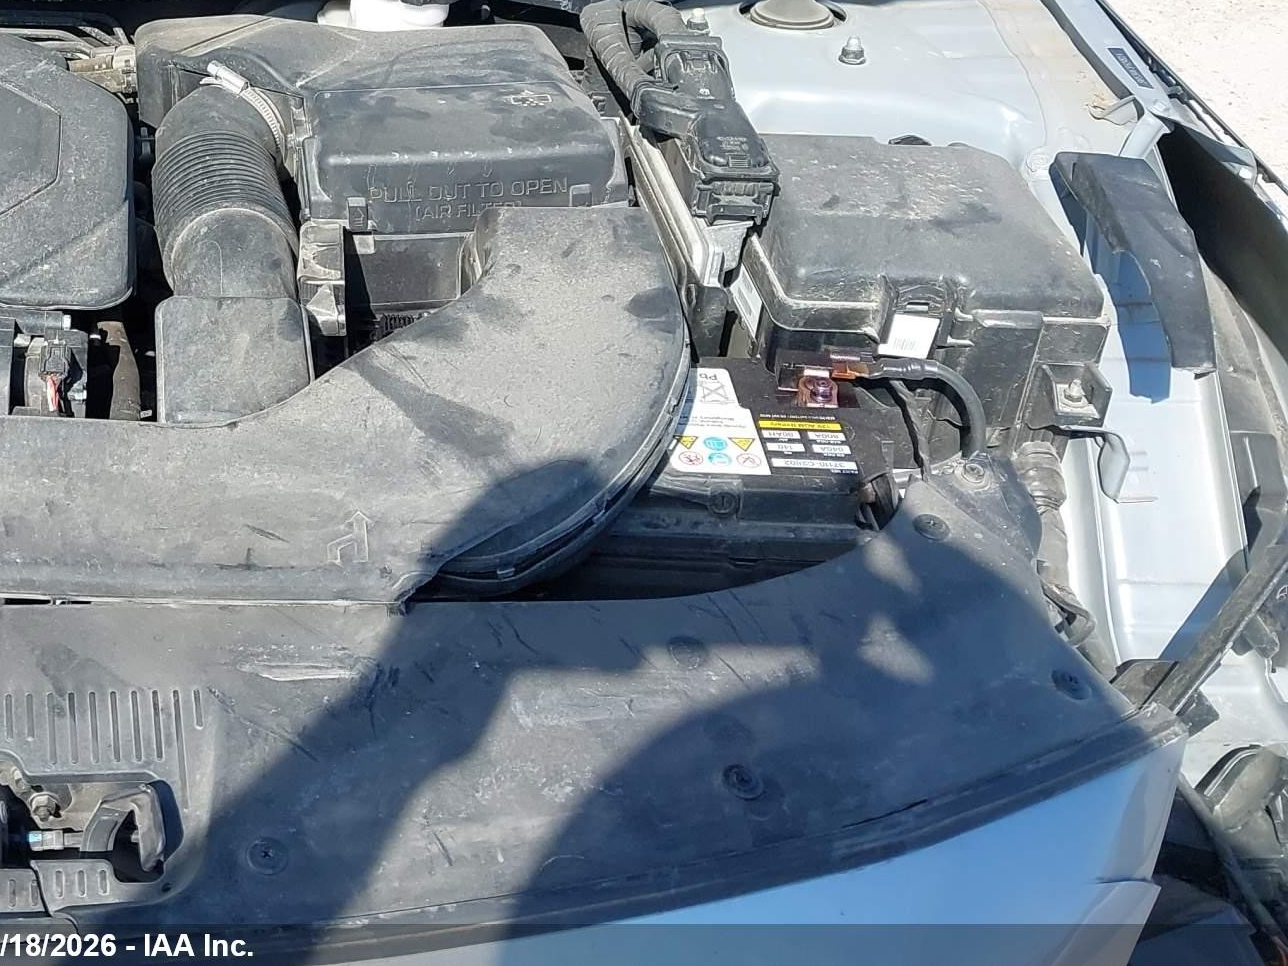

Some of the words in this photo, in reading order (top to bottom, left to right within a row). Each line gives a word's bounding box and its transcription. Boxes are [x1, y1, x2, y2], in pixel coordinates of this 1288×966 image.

[369, 185, 422, 203] PULL
[428, 183, 471, 201] OUT
[475, 181, 504, 197] TO
[512, 177, 568, 196] OPEN
